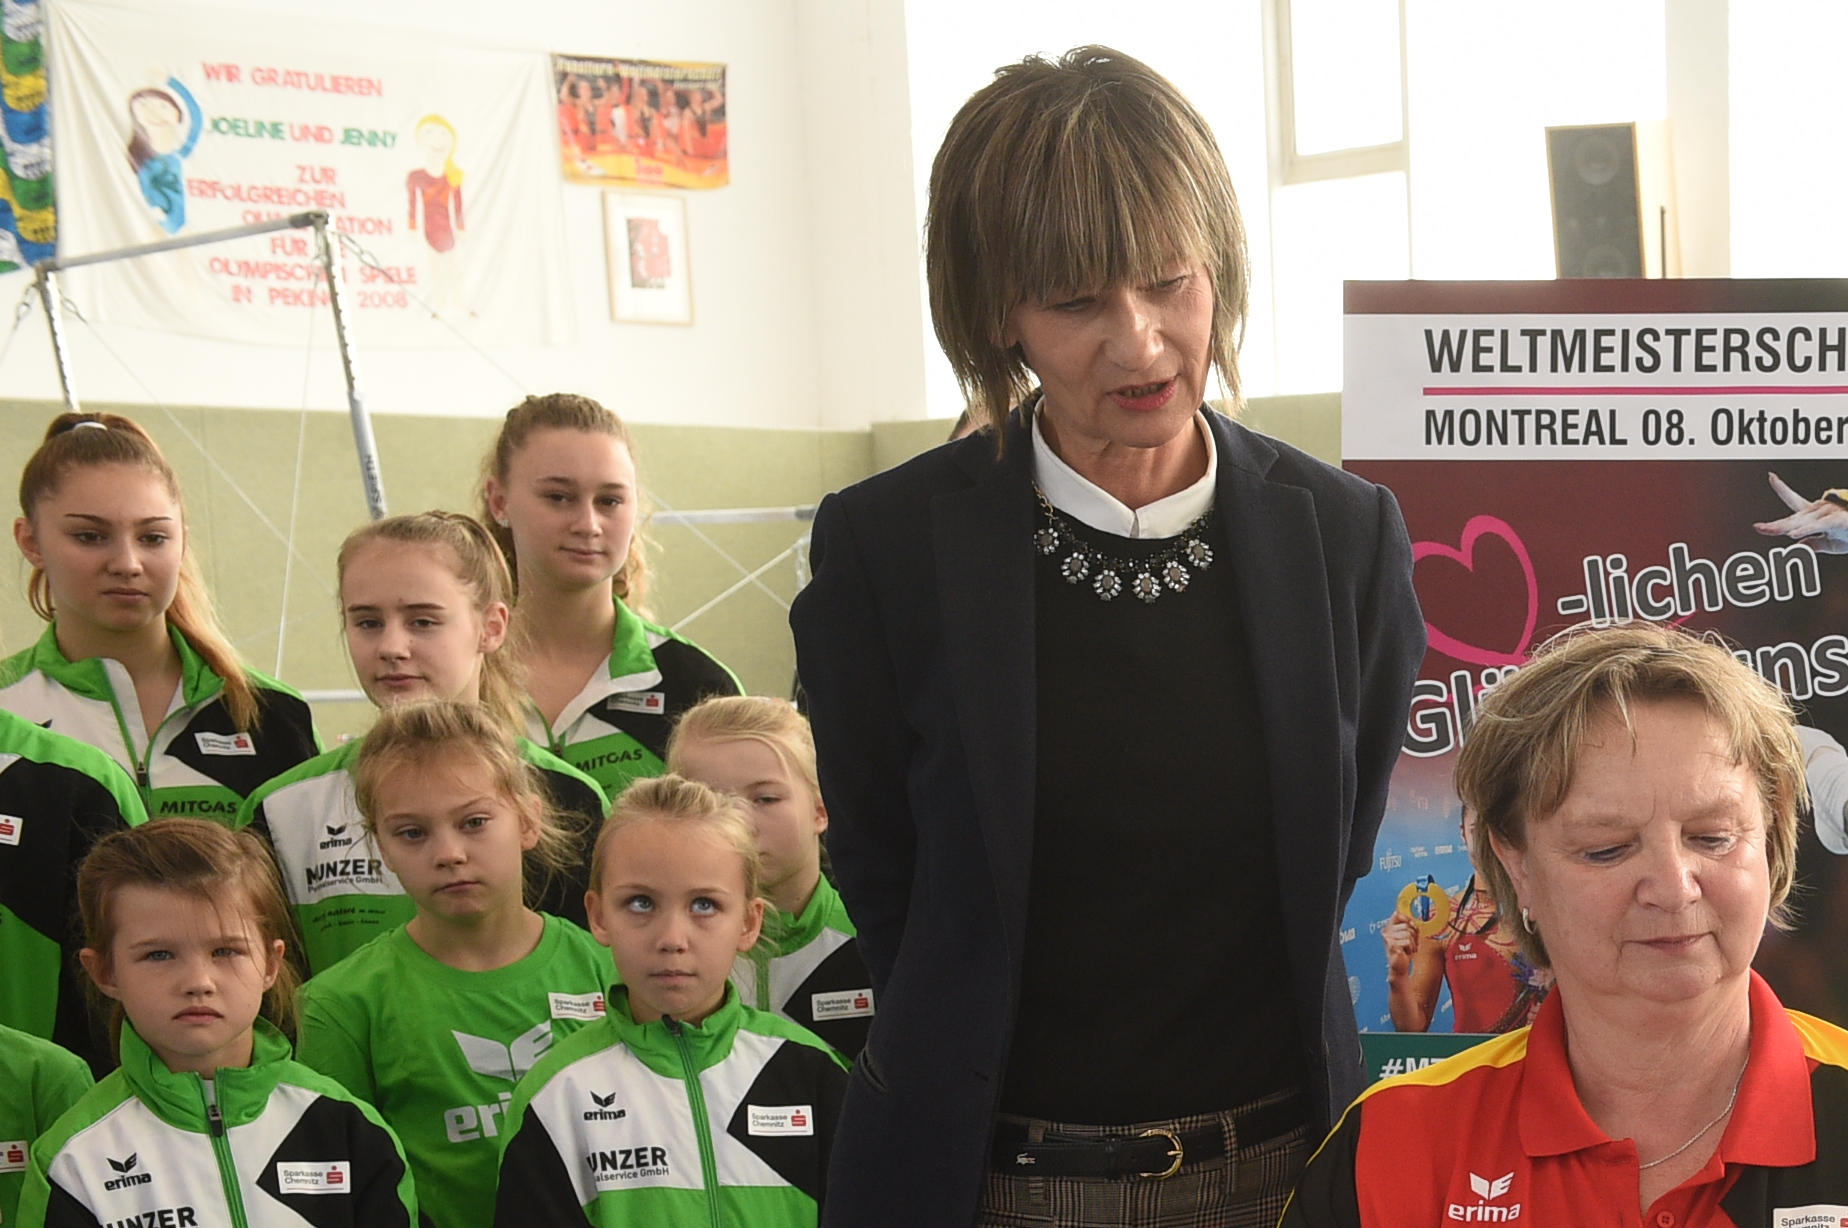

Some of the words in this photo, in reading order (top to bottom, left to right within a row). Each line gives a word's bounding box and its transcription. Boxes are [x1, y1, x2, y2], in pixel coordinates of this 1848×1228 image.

[201, 60, 242, 83] WIR
[250, 66, 383, 97] GRATULIEREN
[289, 123, 334, 145] UND
[340, 127, 398, 149] JENNY
[296, 164, 337, 185] ZUR
[186, 178, 346, 209] ERFOLGREICHEN
[359, 266, 417, 285] SPIELE
[231, 284, 253, 304] IN
[268, 287, 333, 308] PEKIN
[356, 290, 409, 308] 2008
[1423, 408, 1627, 447] MONTREAL
[1641, 408, 1697, 447] 08.
[1557, 541, 1823, 631] -lichen
[575, 749, 643, 772] MITGAS
[160, 800, 237, 815] MITGAS
[319, 837, 353, 850] erima
[816, 998, 852, 1008] Sparkasse
[817, 1004, 849, 1013] Chemnitz
[583, 1108, 626, 1121] erima
[751, 1113, 788, 1122] Sparkasse
[752, 1120, 785, 1128] Chemnitz
[586, 1146, 669, 1173] UNZER
[104, 1170, 152, 1191] erima
[283, 1170, 323, 1179] Sparkasse
[284, 1176, 320, 1185] Chemnitz
[640, 1167, 670, 1178] GmbH
[1448, 1200, 1522, 1223] erima
[1781, 1213, 1836, 1228] Sparkasse
